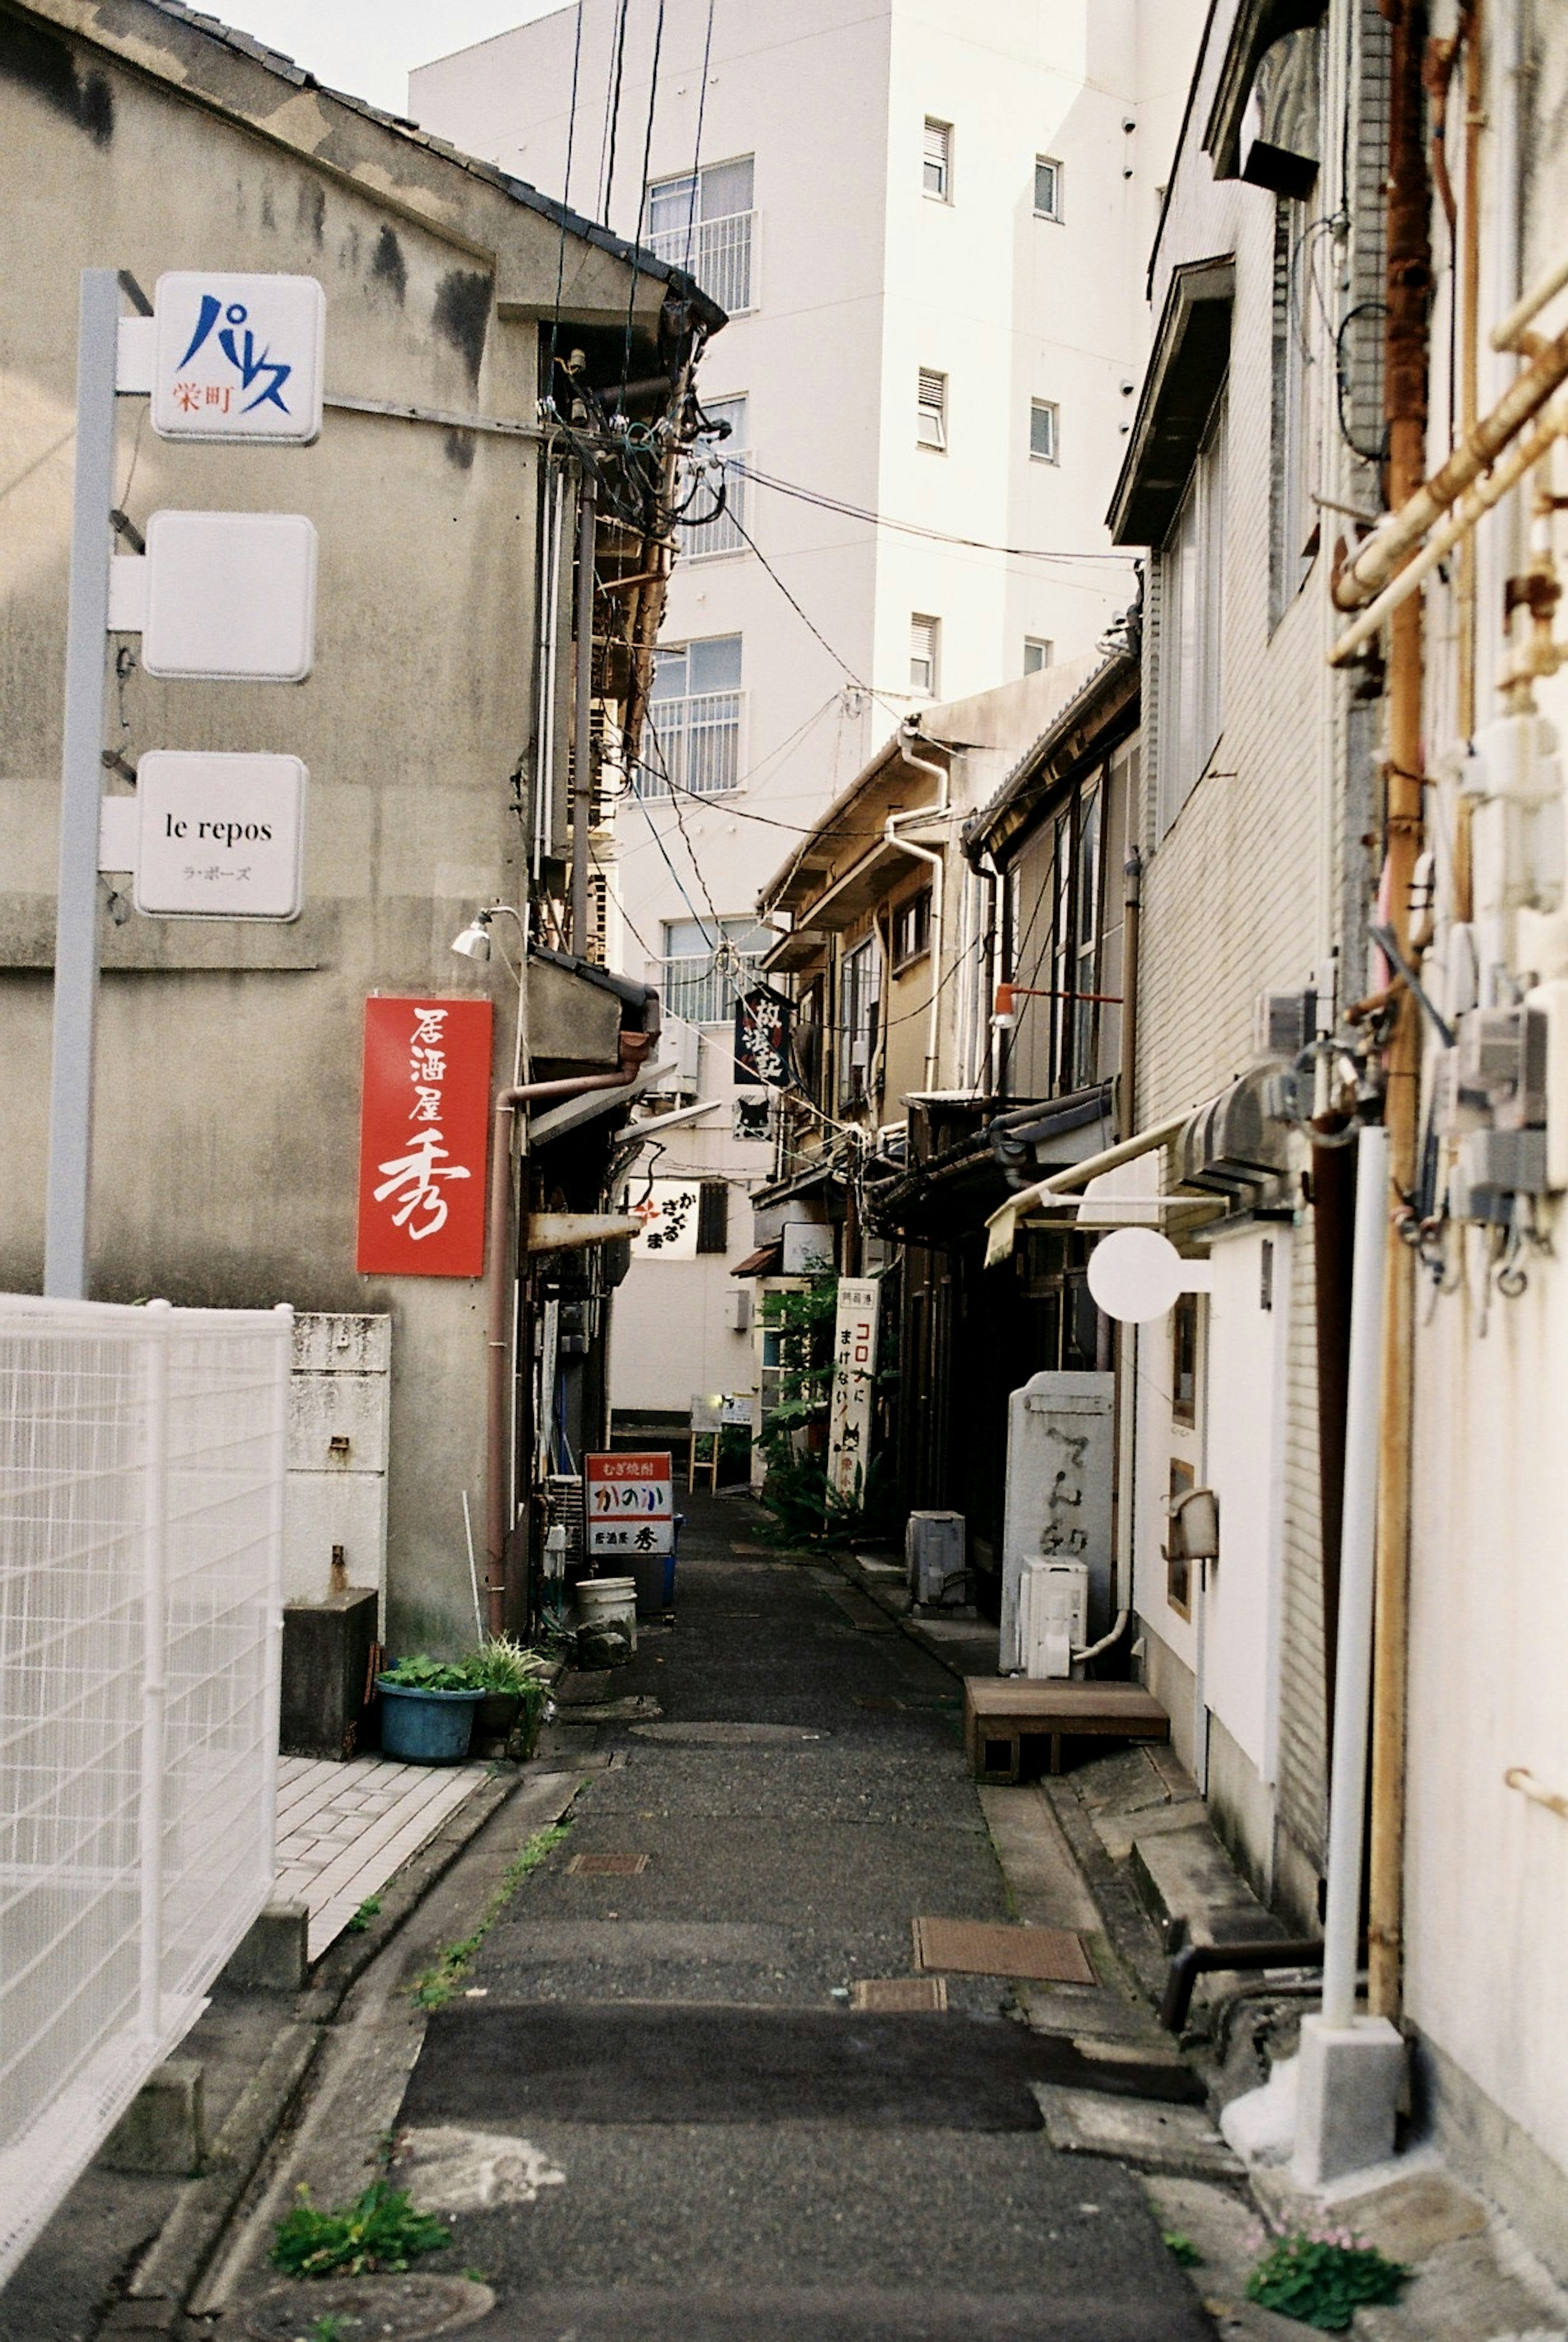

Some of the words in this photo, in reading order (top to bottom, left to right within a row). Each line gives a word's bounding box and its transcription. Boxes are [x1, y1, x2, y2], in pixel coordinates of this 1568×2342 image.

[173, 382, 234, 414] 栄町
[165, 813, 187, 838] le
[198, 822, 272, 847] repos
[409, 1007, 448, 1121] 居酒屋
[373, 1128, 472, 1241] 秀
[647, 1192, 697, 1249] かざぐるま
[603, 1462, 654, 1477] むぎ焼酎
[594, 1485, 663, 1513] かのか
